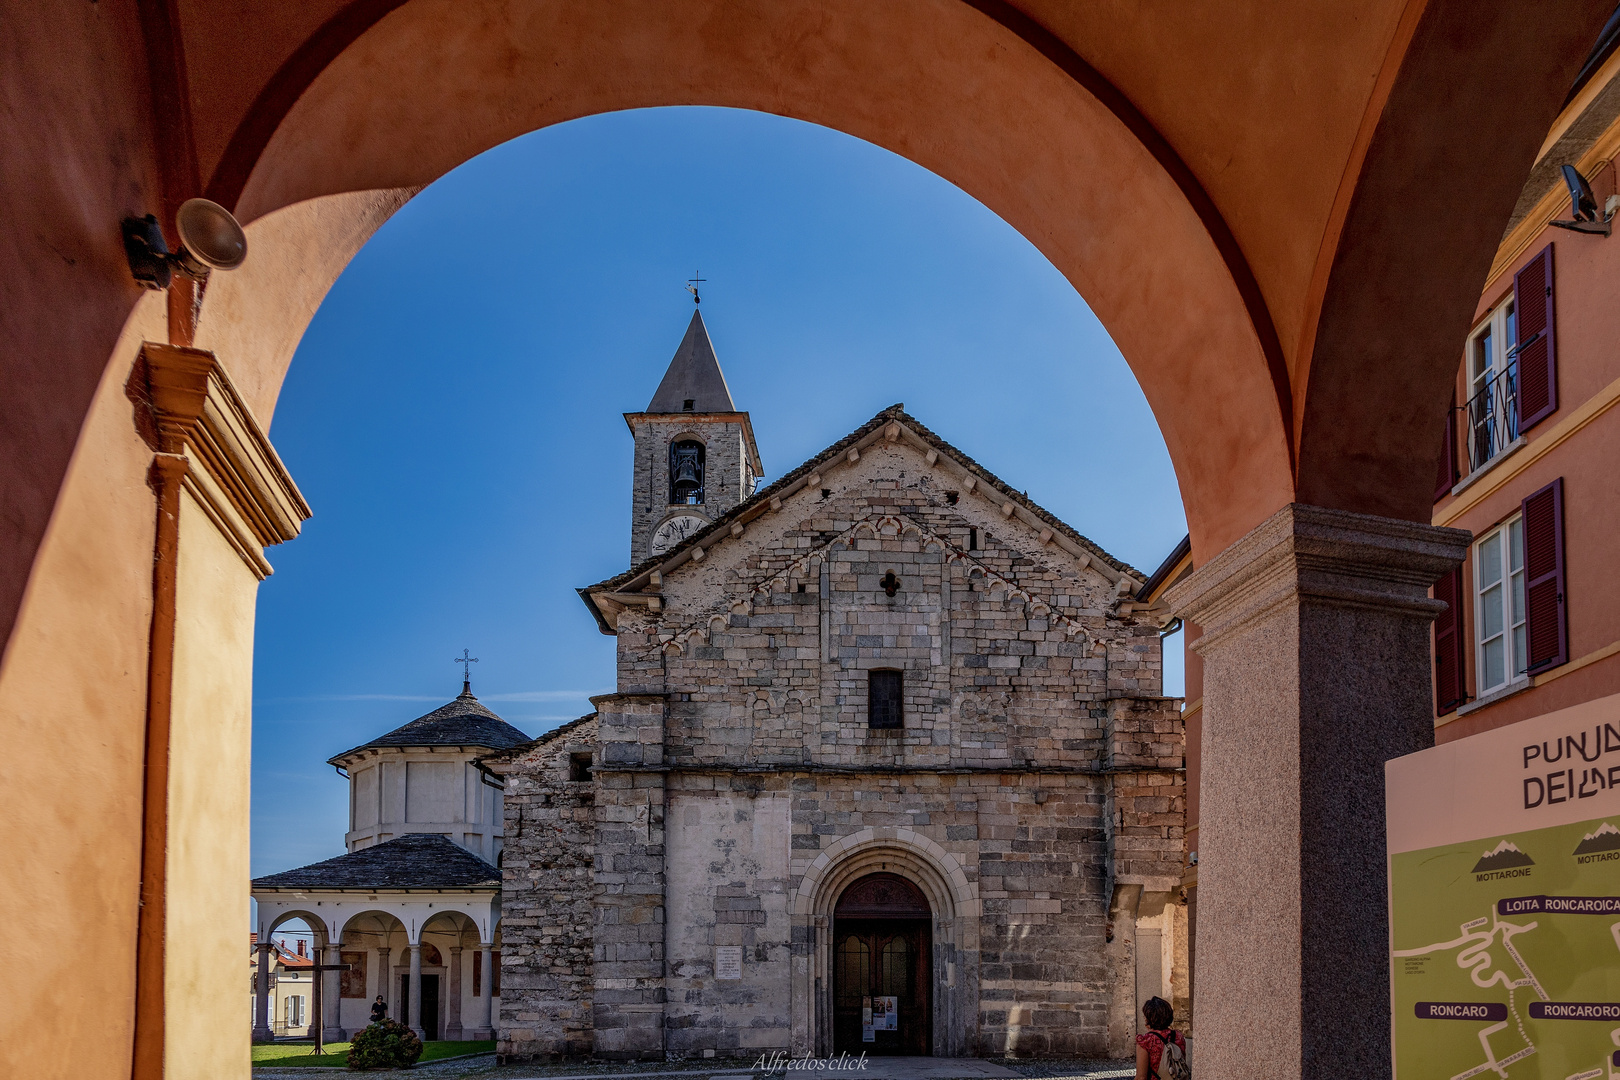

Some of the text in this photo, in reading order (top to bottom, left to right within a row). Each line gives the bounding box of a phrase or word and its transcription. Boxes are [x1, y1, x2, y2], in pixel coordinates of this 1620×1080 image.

[1476, 867, 1531, 882] MOTTARONE
[1506, 899, 1540, 911] LOITA
[1429, 1005, 1488, 1017] RONCARO
